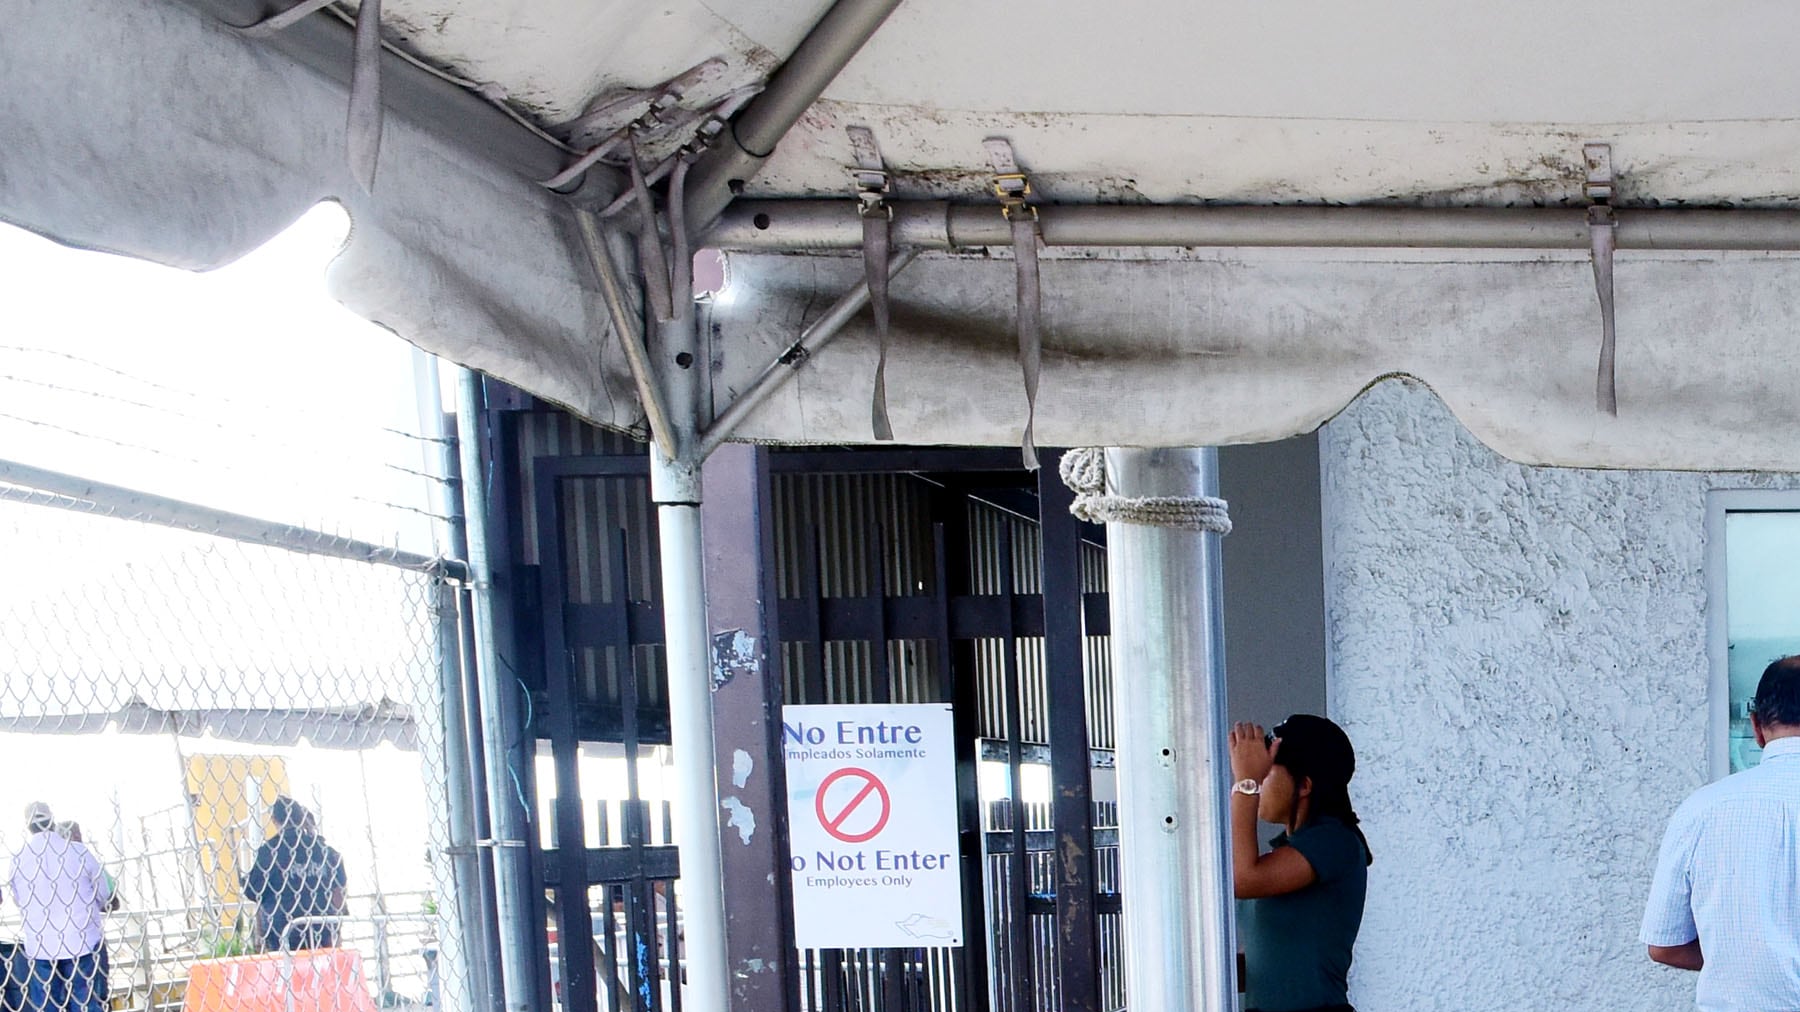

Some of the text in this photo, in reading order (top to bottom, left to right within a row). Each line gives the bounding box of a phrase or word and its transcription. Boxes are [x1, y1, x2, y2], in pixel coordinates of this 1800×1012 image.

[782, 721, 922, 745] No Entre
[788, 748, 927, 762] mpleados Solamente
[816, 851, 866, 871] Not
[876, 850, 951, 871] Enter
[806, 876, 912, 888] Employees Only
